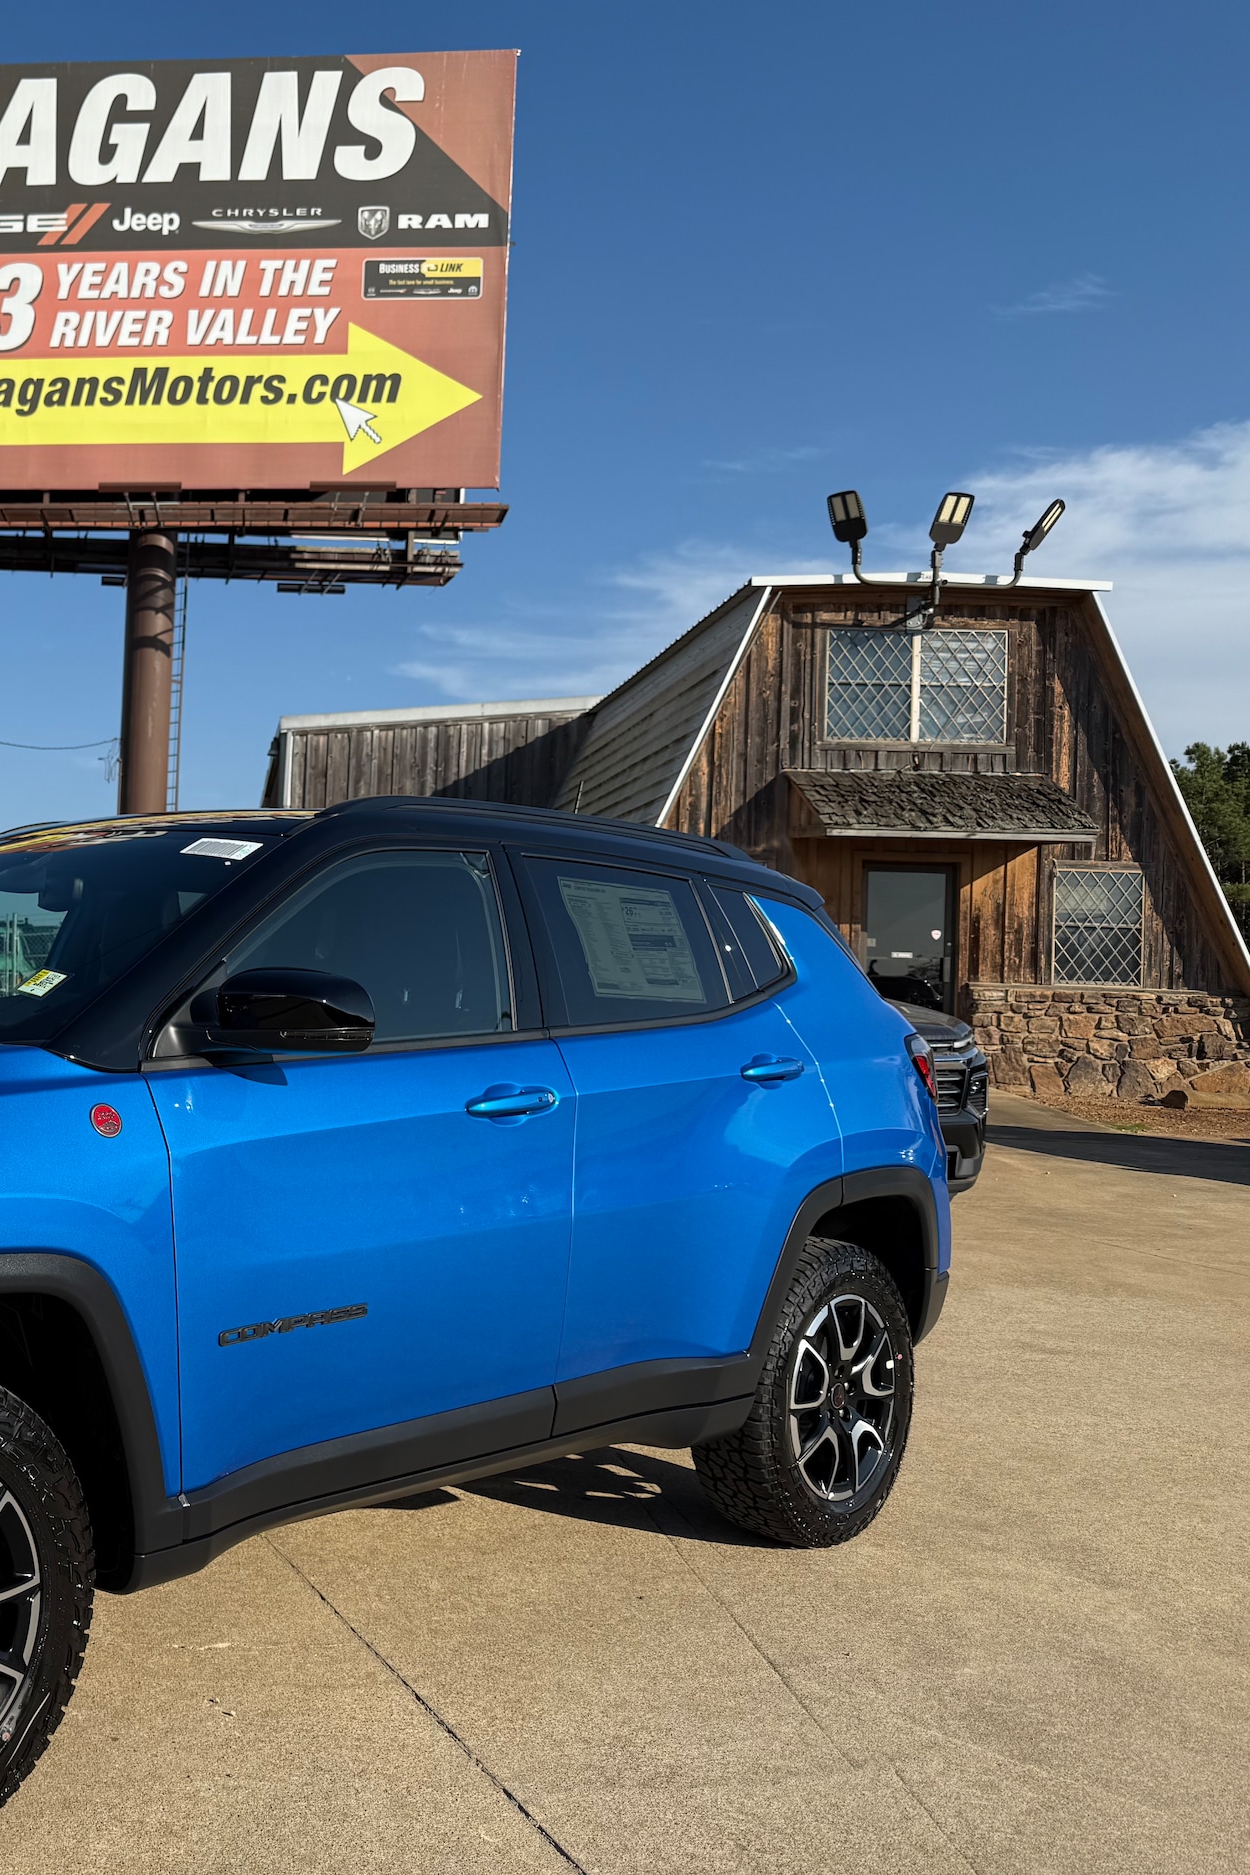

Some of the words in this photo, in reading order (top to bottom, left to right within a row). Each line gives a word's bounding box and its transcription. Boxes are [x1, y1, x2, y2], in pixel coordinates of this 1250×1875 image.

[112, 207, 180, 235] Jeep
[211, 207, 323, 218] CHRYSLER
[397, 213, 490, 229] RAM
[56, 260, 189, 300] YEARS
[199, 259, 255, 298] IN
[258, 258, 338, 297] THE
[378, 263, 420, 274] BUSINESS
[439, 263, 464, 273] LINK
[49, 309, 174, 349] RIVER
[186, 307, 341, 346] VALLEY
[217, 1302, 368, 1347] COMPASS
